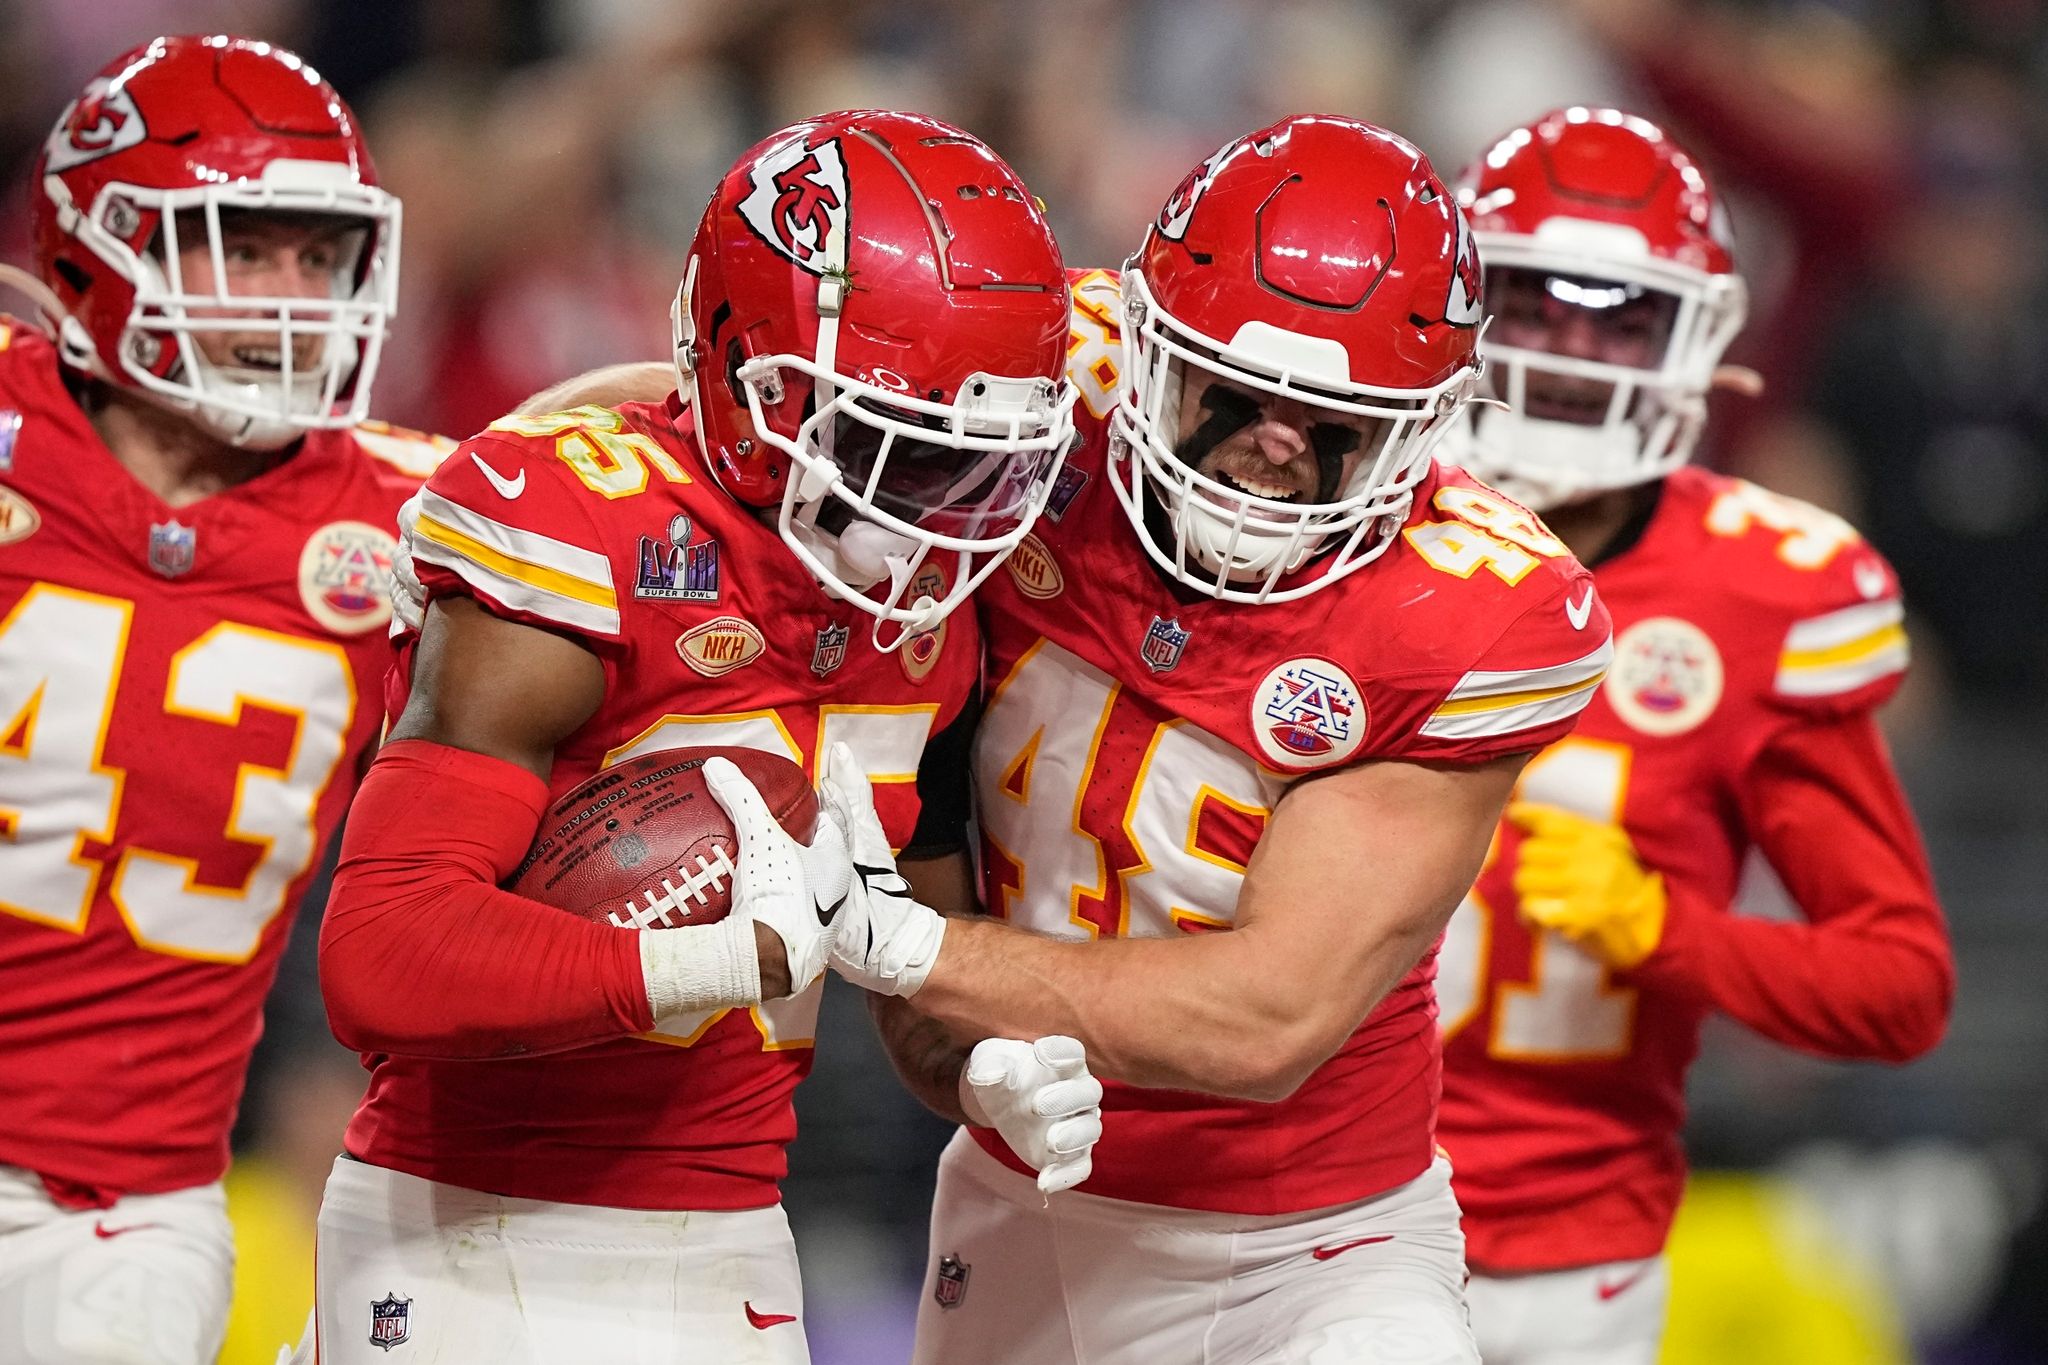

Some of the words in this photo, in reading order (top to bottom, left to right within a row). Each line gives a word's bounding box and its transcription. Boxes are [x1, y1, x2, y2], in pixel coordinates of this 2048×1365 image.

[772, 153, 841, 262] KC
[1012, 547, 1047, 586] NKH
[644, 589, 678, 597] SUPER
[683, 590, 711, 599] BOWL
[702, 634, 746, 661] NKH
[817, 648, 841, 669] NFL
[1146, 636, 1174, 664] NFL
[1287, 732, 1315, 751] LH
[0, 581, 357, 966] 43
[630, 758, 705, 791] NATIONAL
[654, 779, 675, 792] LAS
[555, 788, 629, 838] FOOTBALL
[640, 791, 676, 812] CHIEFS
[374, 1318, 404, 1341] NFL
